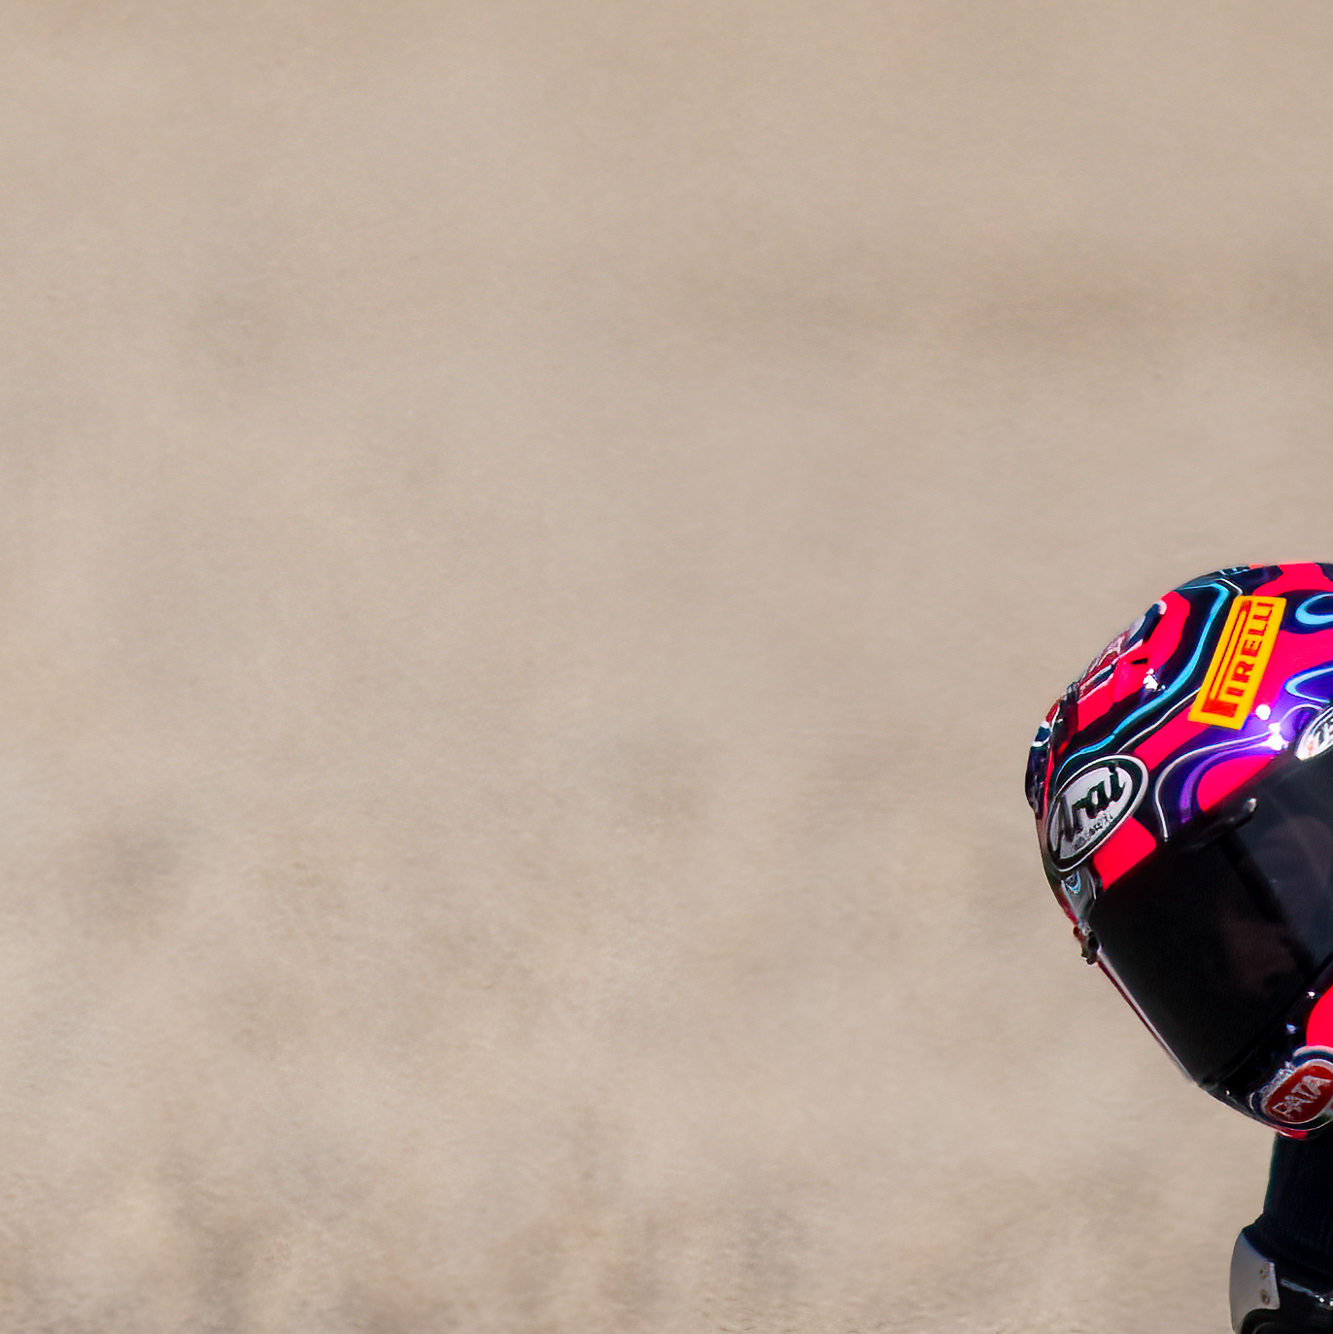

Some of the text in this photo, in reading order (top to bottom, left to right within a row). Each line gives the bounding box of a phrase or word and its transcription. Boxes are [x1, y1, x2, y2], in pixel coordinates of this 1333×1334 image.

[1200, 600, 1274, 718] PIRELLI
[1056, 764, 1126, 857] Arai
[1272, 1075, 1333, 1121] PATA
